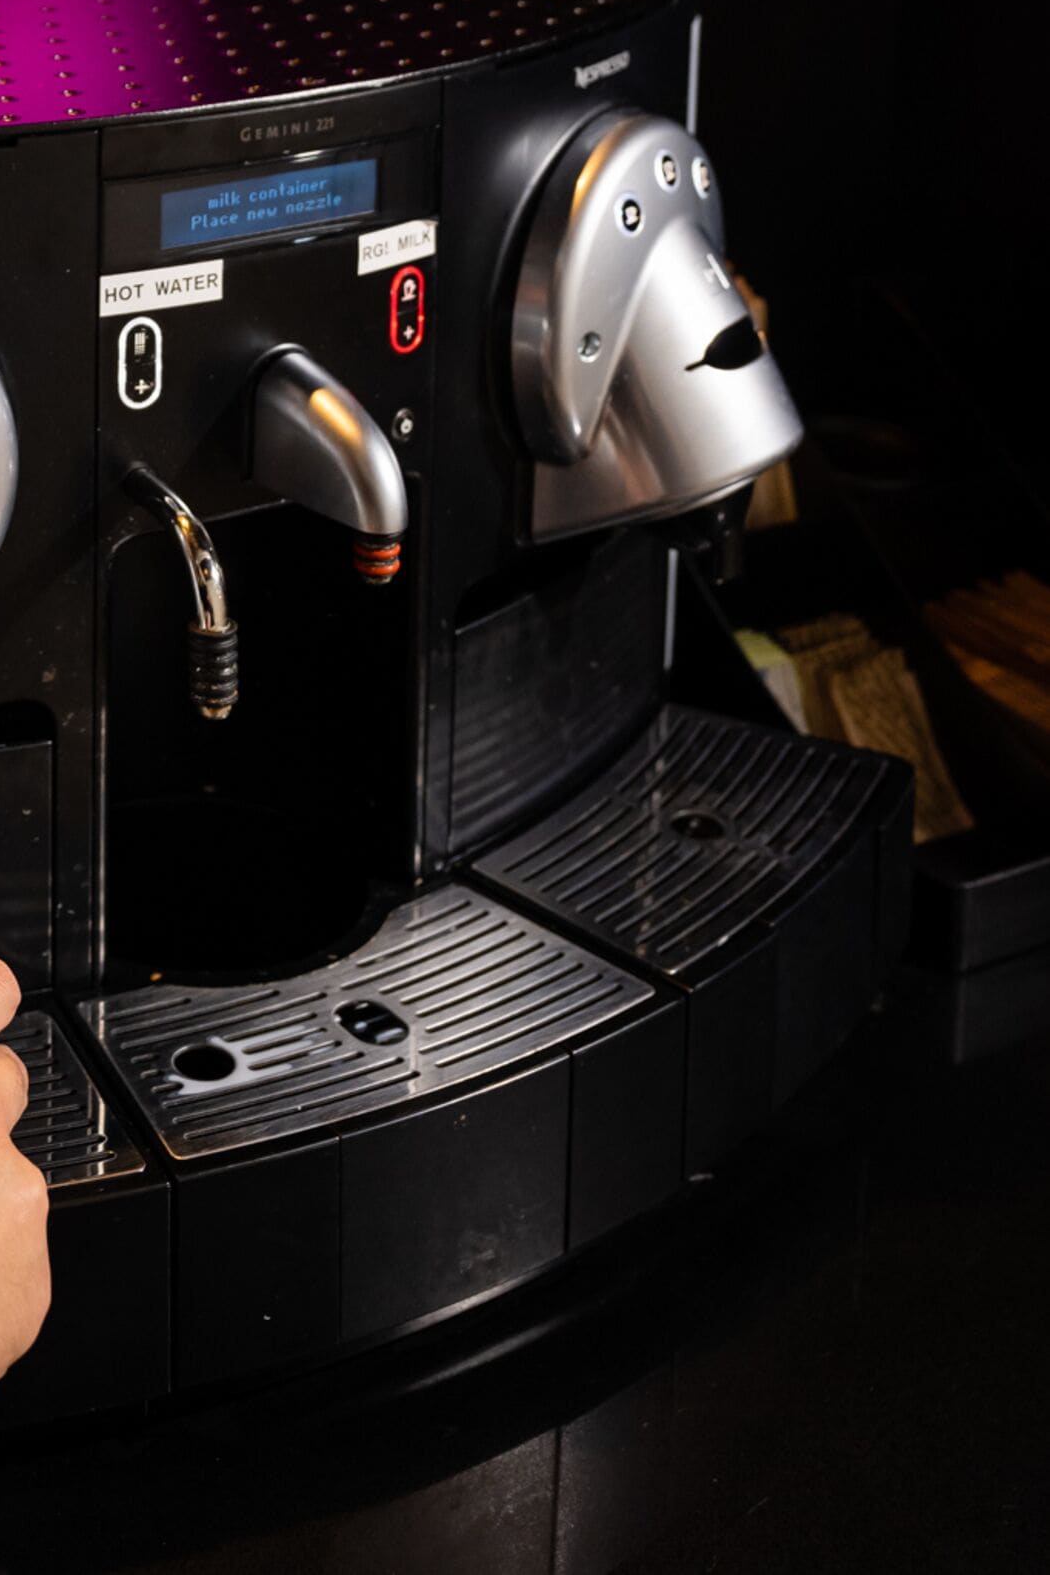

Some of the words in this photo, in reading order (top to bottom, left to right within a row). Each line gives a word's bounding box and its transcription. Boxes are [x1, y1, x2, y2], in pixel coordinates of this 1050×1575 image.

[239, 120, 310, 143] GEMINI
[207, 190, 241, 210] milk
[249, 178, 327, 203] container
[190, 211, 239, 231] Place
[246, 206, 279, 222] new
[285, 192, 343, 215] nozzle
[397, 228, 432, 252] MILK
[104, 283, 145, 304] HOT
[155, 272, 219, 297] WATER
